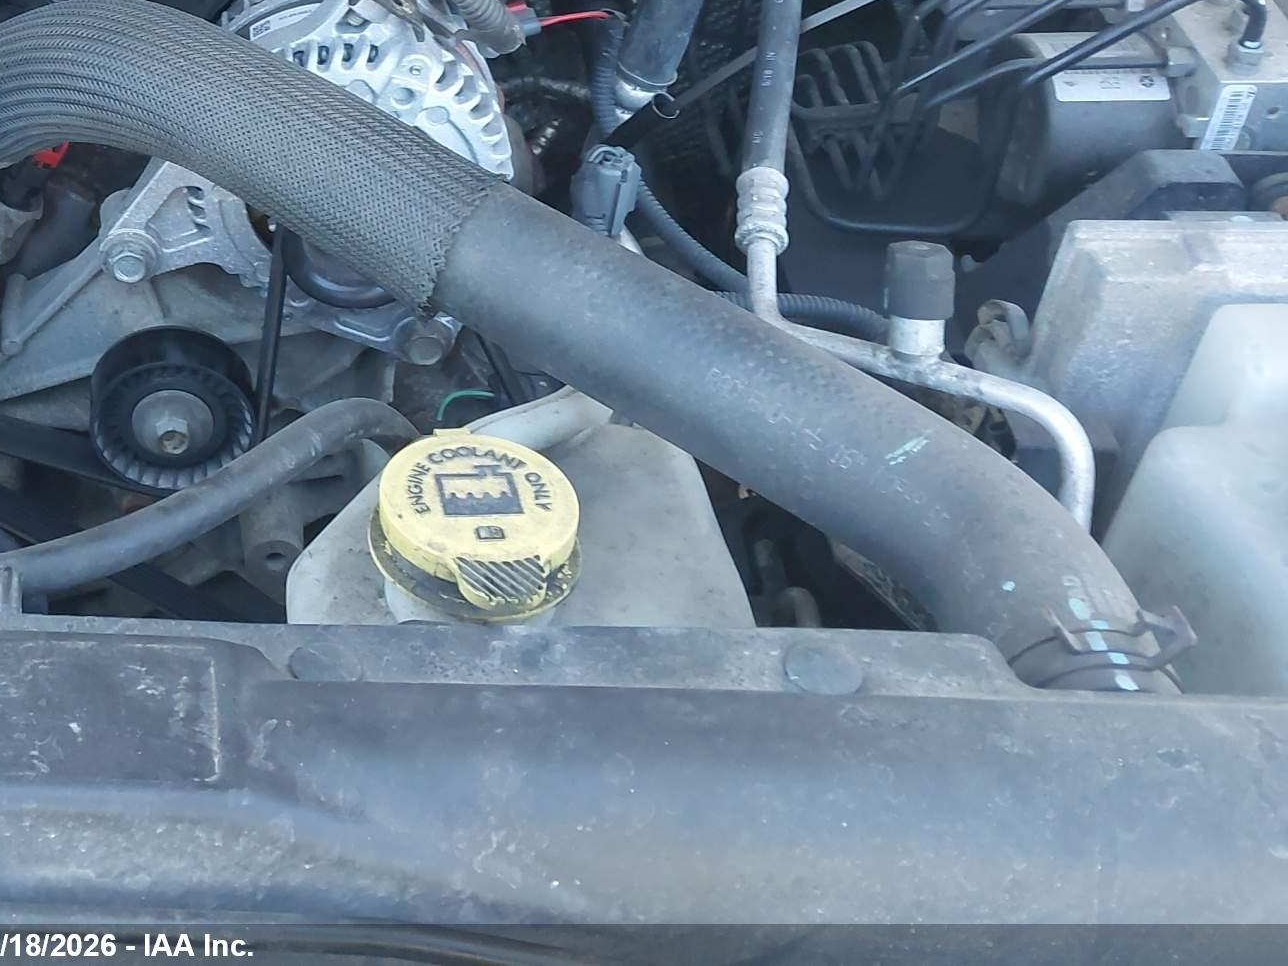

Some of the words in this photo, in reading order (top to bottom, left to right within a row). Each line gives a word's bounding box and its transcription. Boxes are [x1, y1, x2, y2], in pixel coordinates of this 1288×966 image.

[408, 462, 432, 516] ENGINE
[428, 446, 527, 470] COOLANT
[524, 472, 552, 512] ONLY
